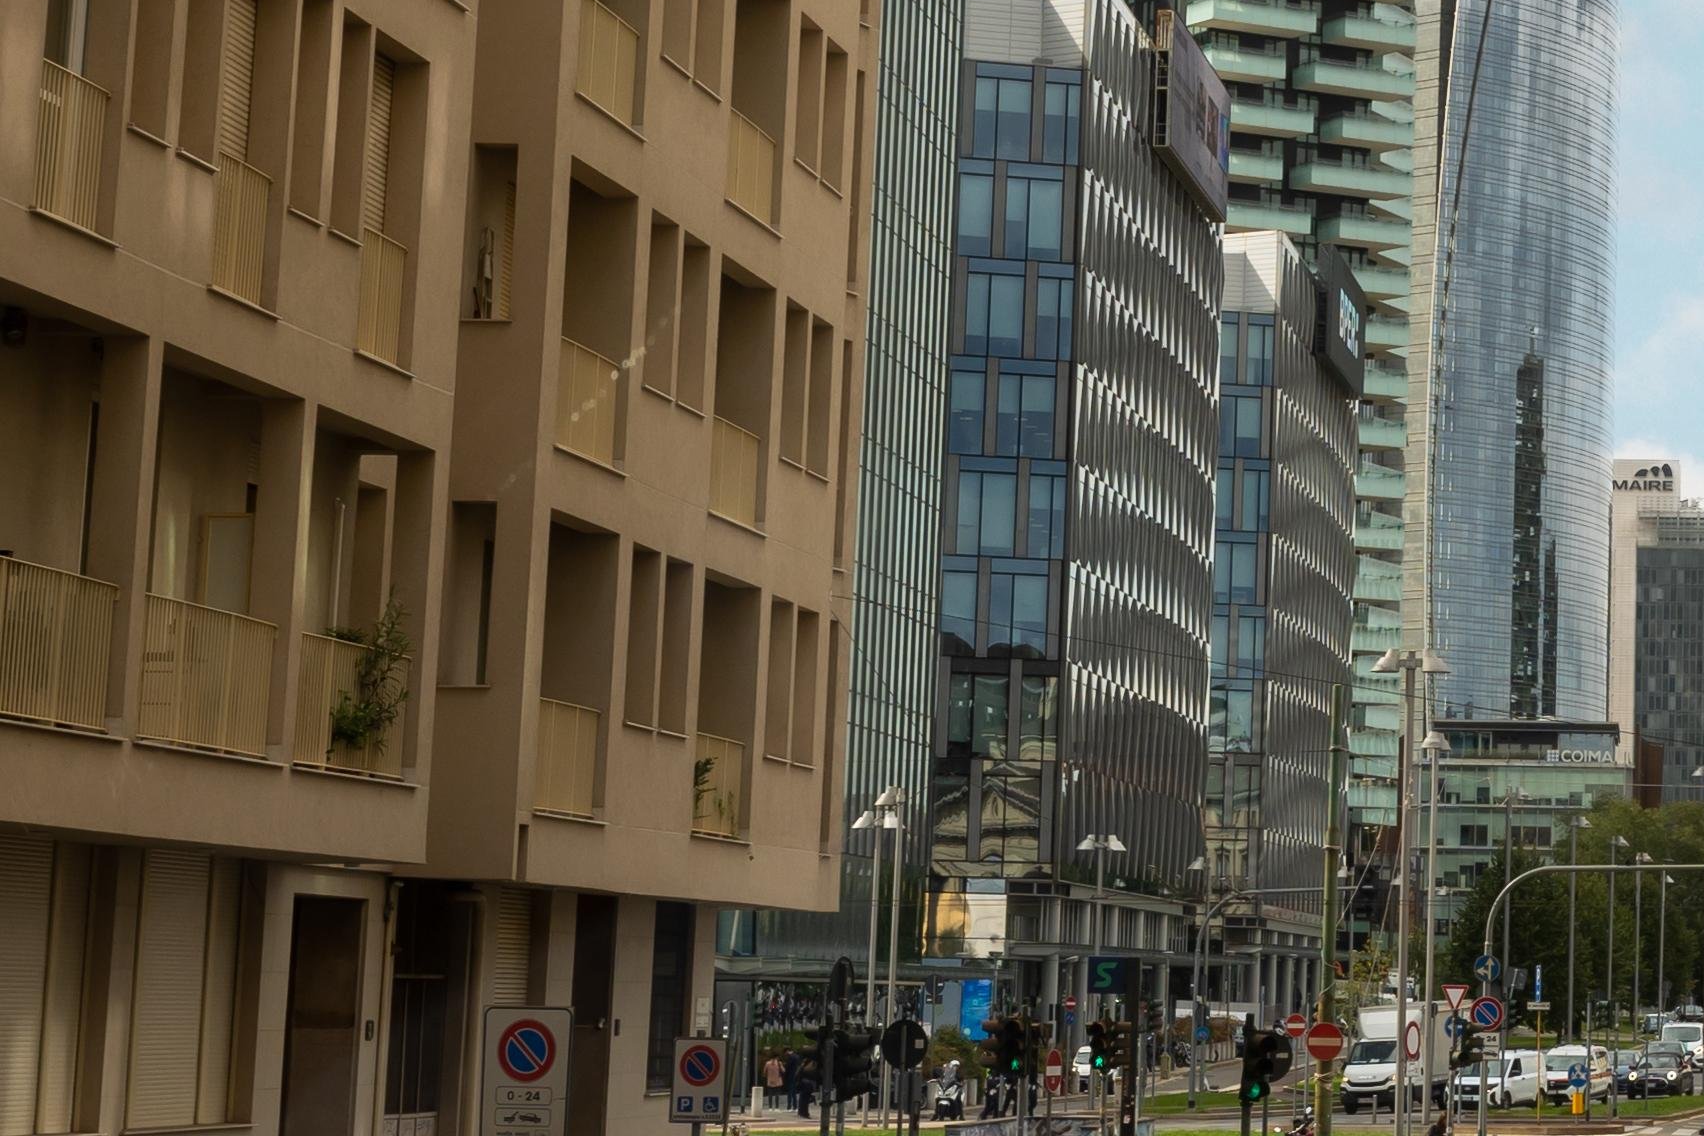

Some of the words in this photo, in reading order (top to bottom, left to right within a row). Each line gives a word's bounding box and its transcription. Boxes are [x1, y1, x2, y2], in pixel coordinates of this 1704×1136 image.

[1613, 479, 1673, 492] MAIRE
[1561, 749, 1615, 763] COIMA
[1093, 962, 1119, 988] S
[507, 1090, 514, 1101] 0
[525, 1091, 541, 1101] 24
[680, 1098, 691, 1111] P
